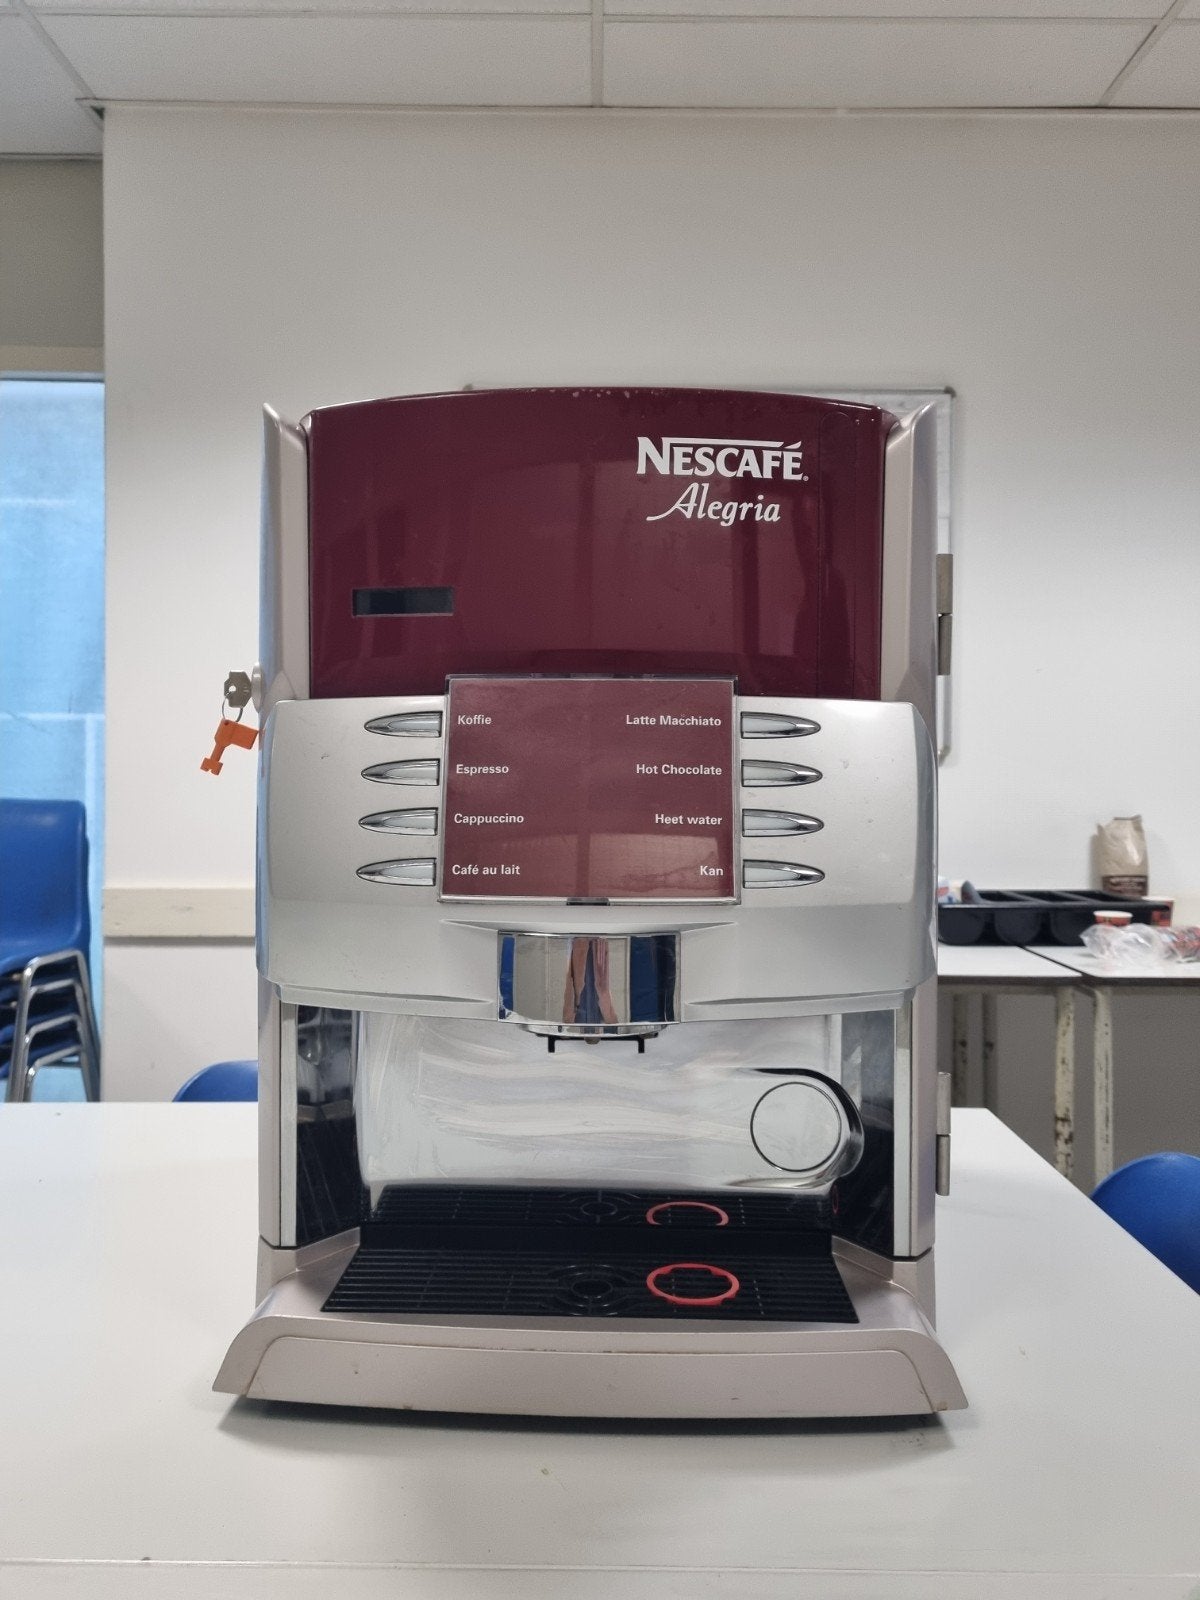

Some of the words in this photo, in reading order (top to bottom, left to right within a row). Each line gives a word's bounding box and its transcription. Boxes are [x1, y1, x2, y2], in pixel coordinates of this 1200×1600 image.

[636, 436, 803, 480] NESCAFÉ
[646, 482, 781, 527] Alegria
[457, 715, 492, 725] Koffie
[626, 715, 656, 725] Latte
[659, 715, 722, 726] Macchiato
[456, 764, 509, 776] Espresso
[636, 764, 658, 775] Hot
[661, 764, 722, 776] Chocolate
[454, 813, 524, 826] Cappuccino
[655, 813, 684, 825] Heet
[687, 815, 723, 825] water
[452, 864, 479, 875] Café
[482, 867, 497, 875] au
[501, 864, 521, 875] lait
[700, 865, 724, 876] Kan
